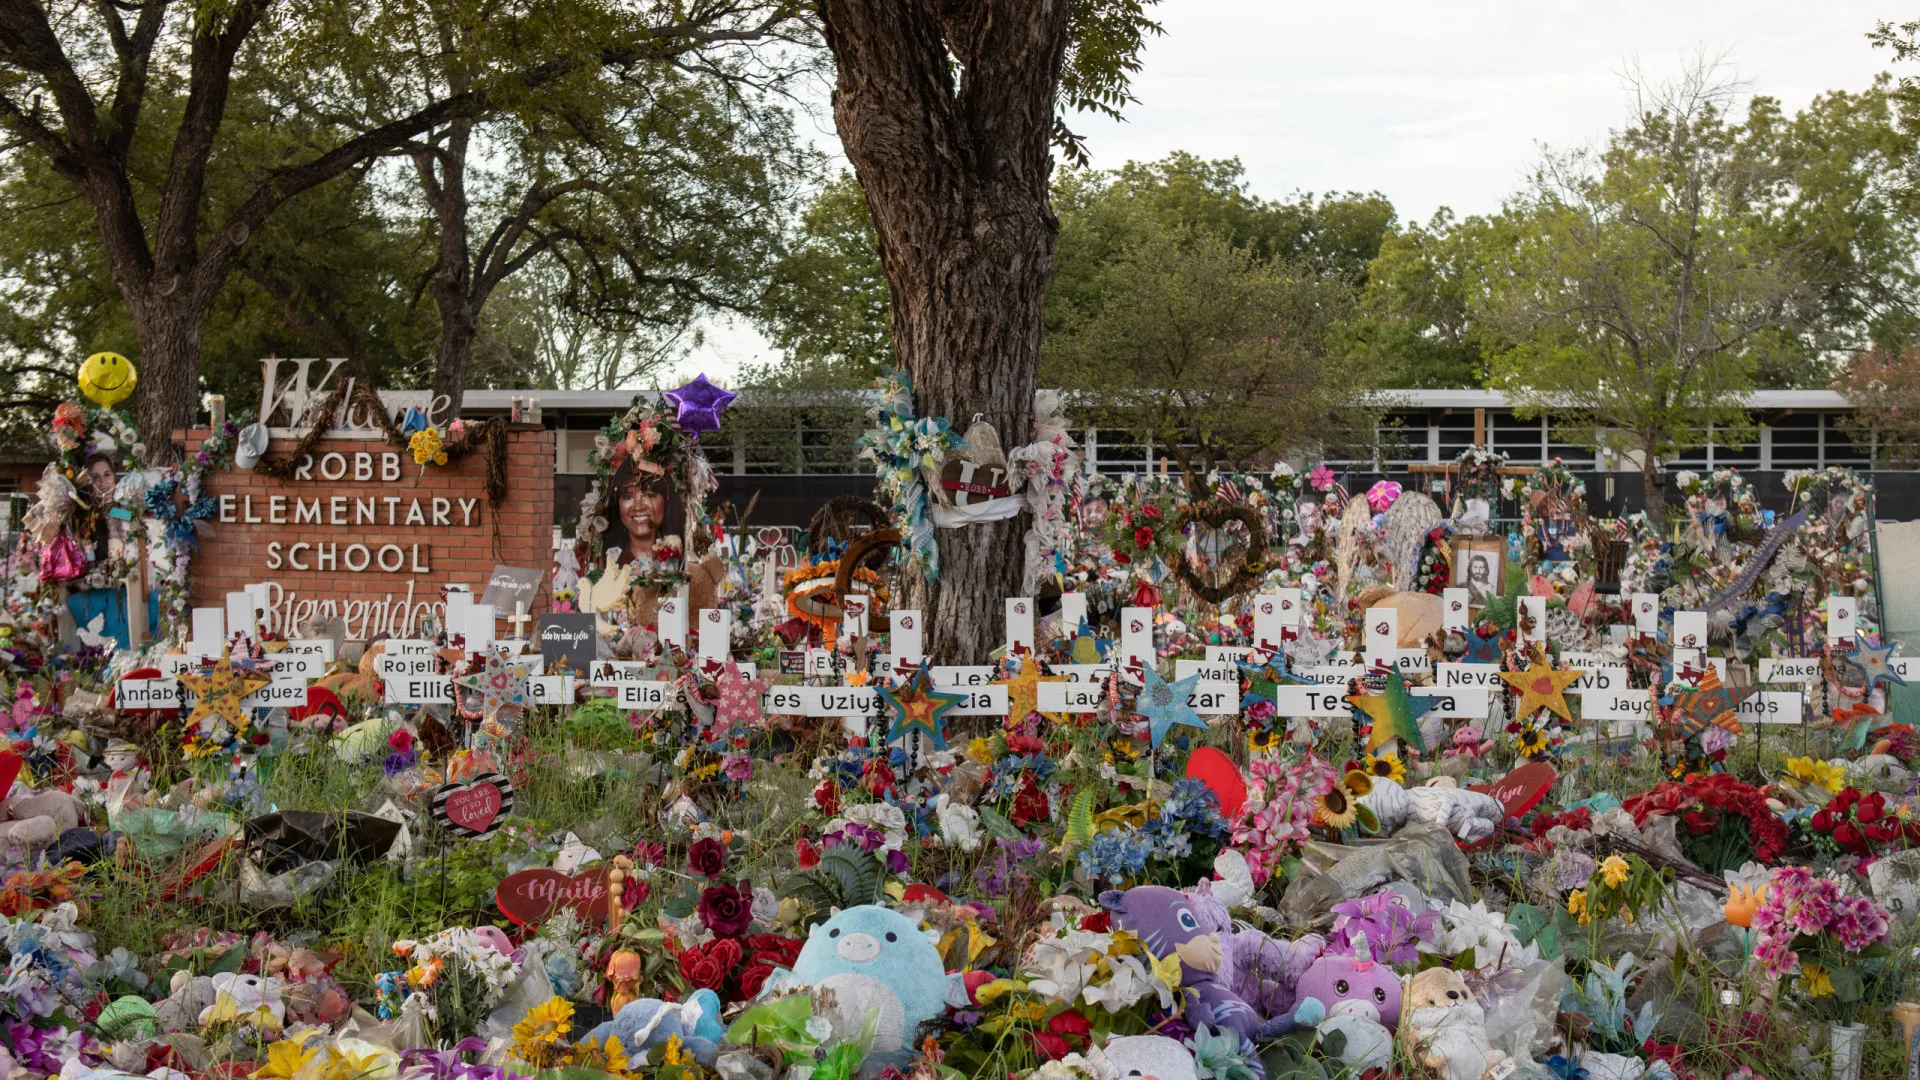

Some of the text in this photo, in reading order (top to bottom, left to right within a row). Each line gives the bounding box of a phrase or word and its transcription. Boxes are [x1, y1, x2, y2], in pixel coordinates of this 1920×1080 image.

[295, 452, 401, 482] ROBB
[219, 494, 478, 527] ELEMENTARY
[266, 540, 430, 573] SCHOOL
[541, 628, 554, 641] side
[553, 632, 561, 642] by
[561, 628, 573, 641] side
[454, 788, 490, 806] YOU ARE
[461, 796, 493, 822] loved
[470, 800, 481, 809] SO
